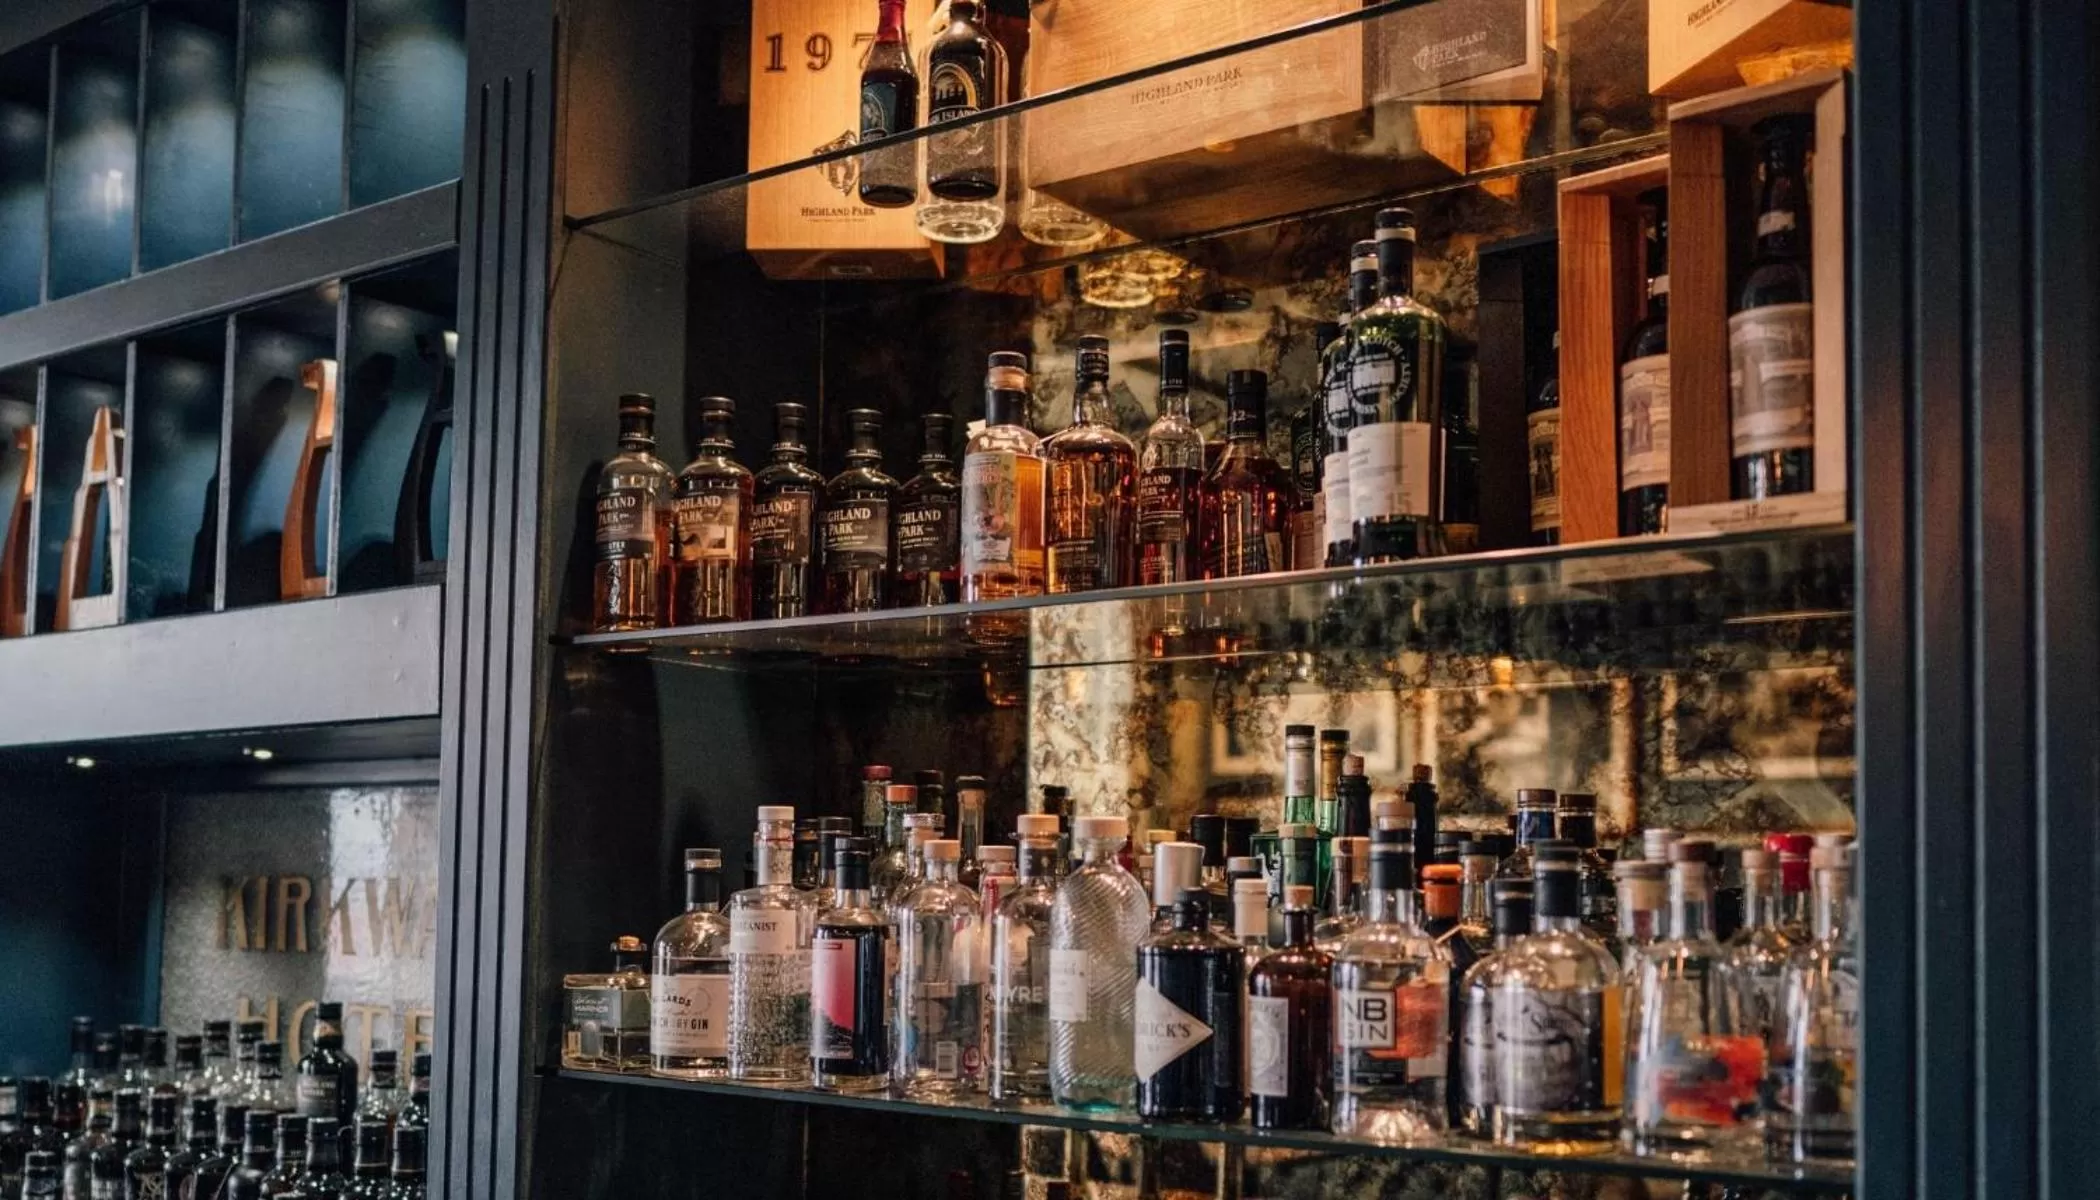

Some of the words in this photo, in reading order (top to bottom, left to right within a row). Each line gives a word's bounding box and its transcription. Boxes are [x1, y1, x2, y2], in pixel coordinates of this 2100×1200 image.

[1131, 77, 1204, 105] HIGHLAND
[1206, 66, 1243, 86] PARK
[801, 206, 849, 217] HIGHLAND
[851, 206, 876, 216] PARK
[828, 522, 854, 537] PARK
[900, 525, 924, 538] PARK
[1339, 997, 1387, 1021] NB
[690, 1018, 709, 1030] GIN
